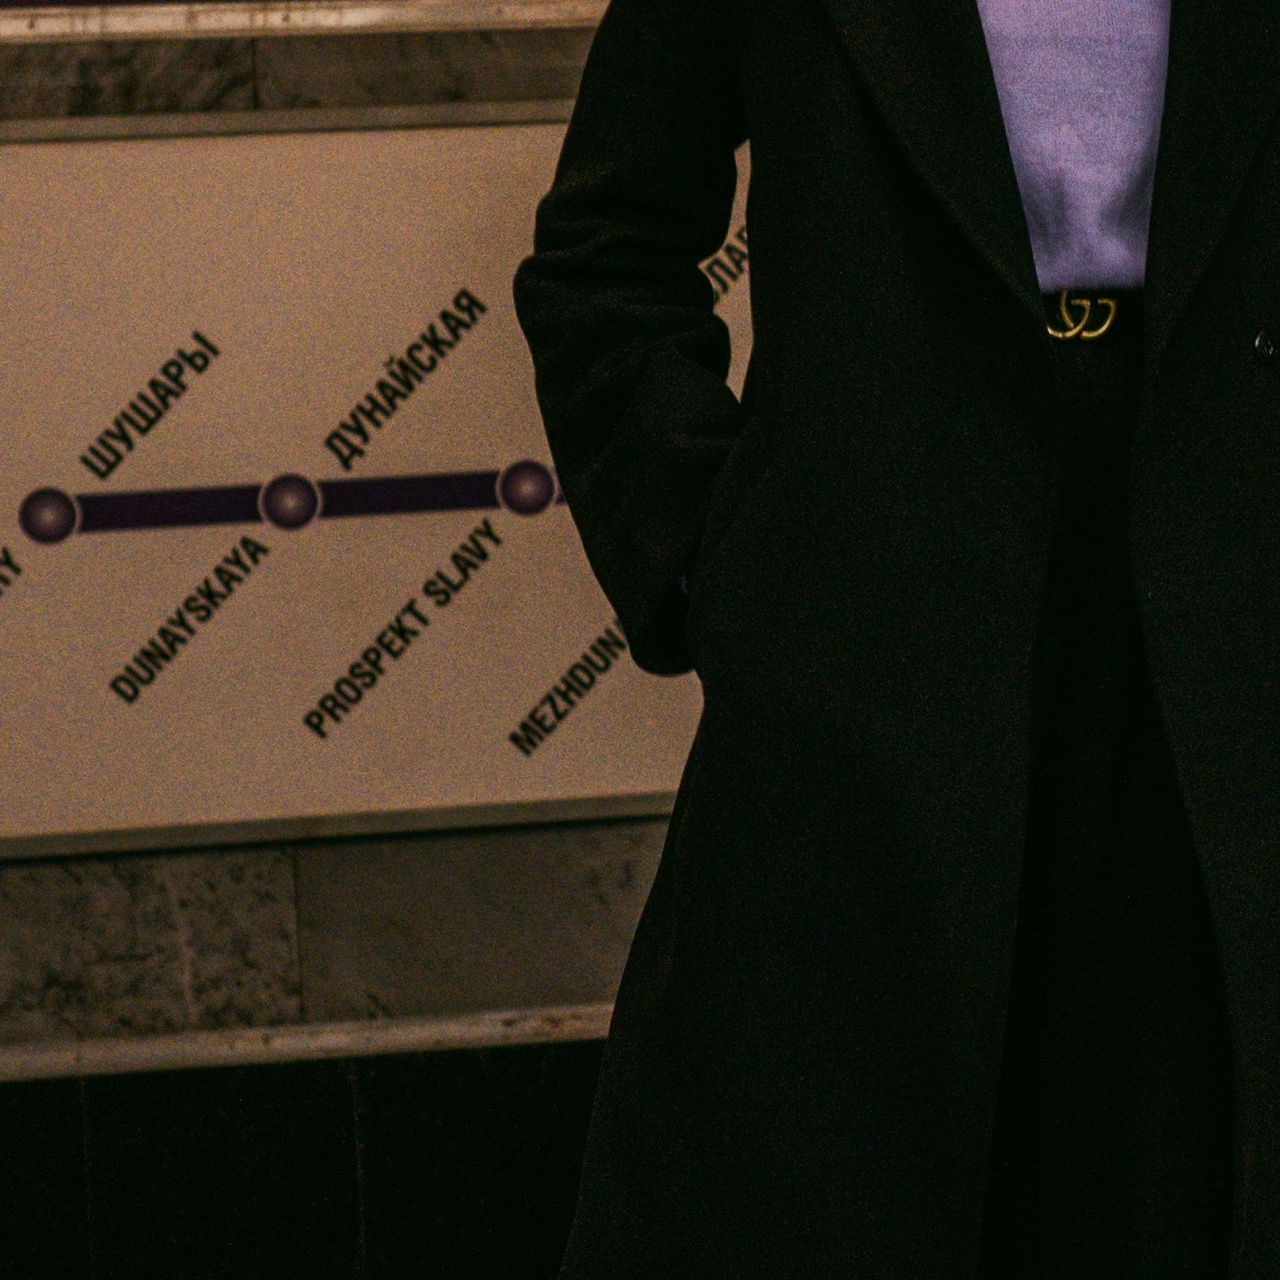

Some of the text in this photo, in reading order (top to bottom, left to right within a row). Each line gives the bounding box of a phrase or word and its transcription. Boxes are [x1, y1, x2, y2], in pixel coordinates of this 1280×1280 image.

[79, 331, 222, 480] ШУШАРЫ
[323, 288, 489, 470] ДУНАЙСКАЯ
[109, 535, 270, 704] DUNAYSKAYA
[302, 518, 505, 739] PROSPEKT SLAVY
[508, 622, 628, 757] MEZHDUN
